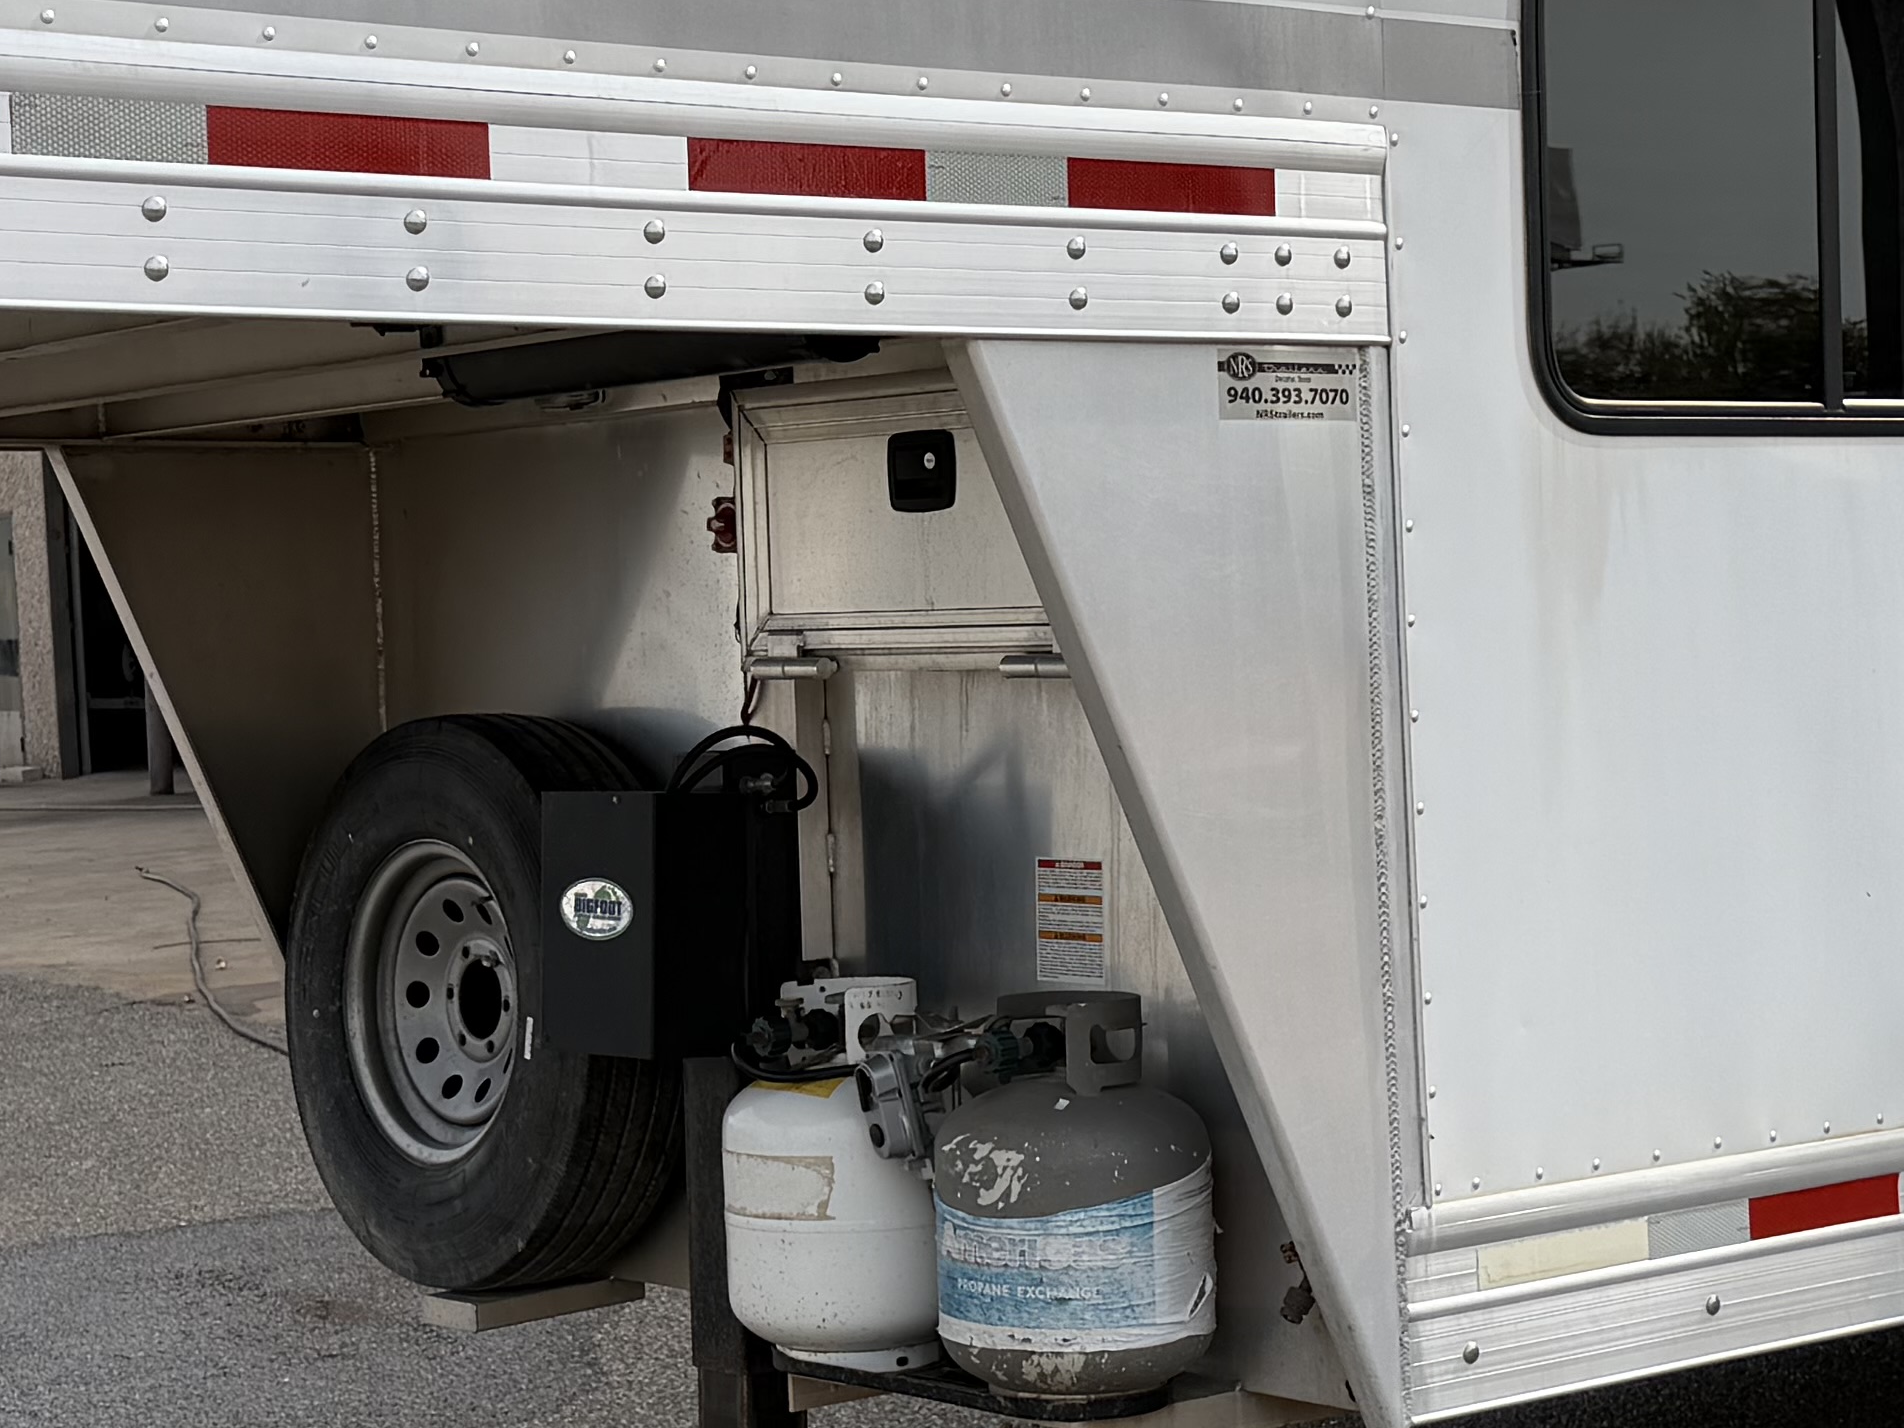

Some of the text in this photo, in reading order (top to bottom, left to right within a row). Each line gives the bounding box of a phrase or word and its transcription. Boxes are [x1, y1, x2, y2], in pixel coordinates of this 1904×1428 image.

[1226, 386, 1350, 406] 940.393.7070
[574, 897, 622, 916] BIGFOOT
[940, 1220, 1131, 1270] AmeriGas
[957, 1278, 1102, 1301] PROPANE EXCHANGE
